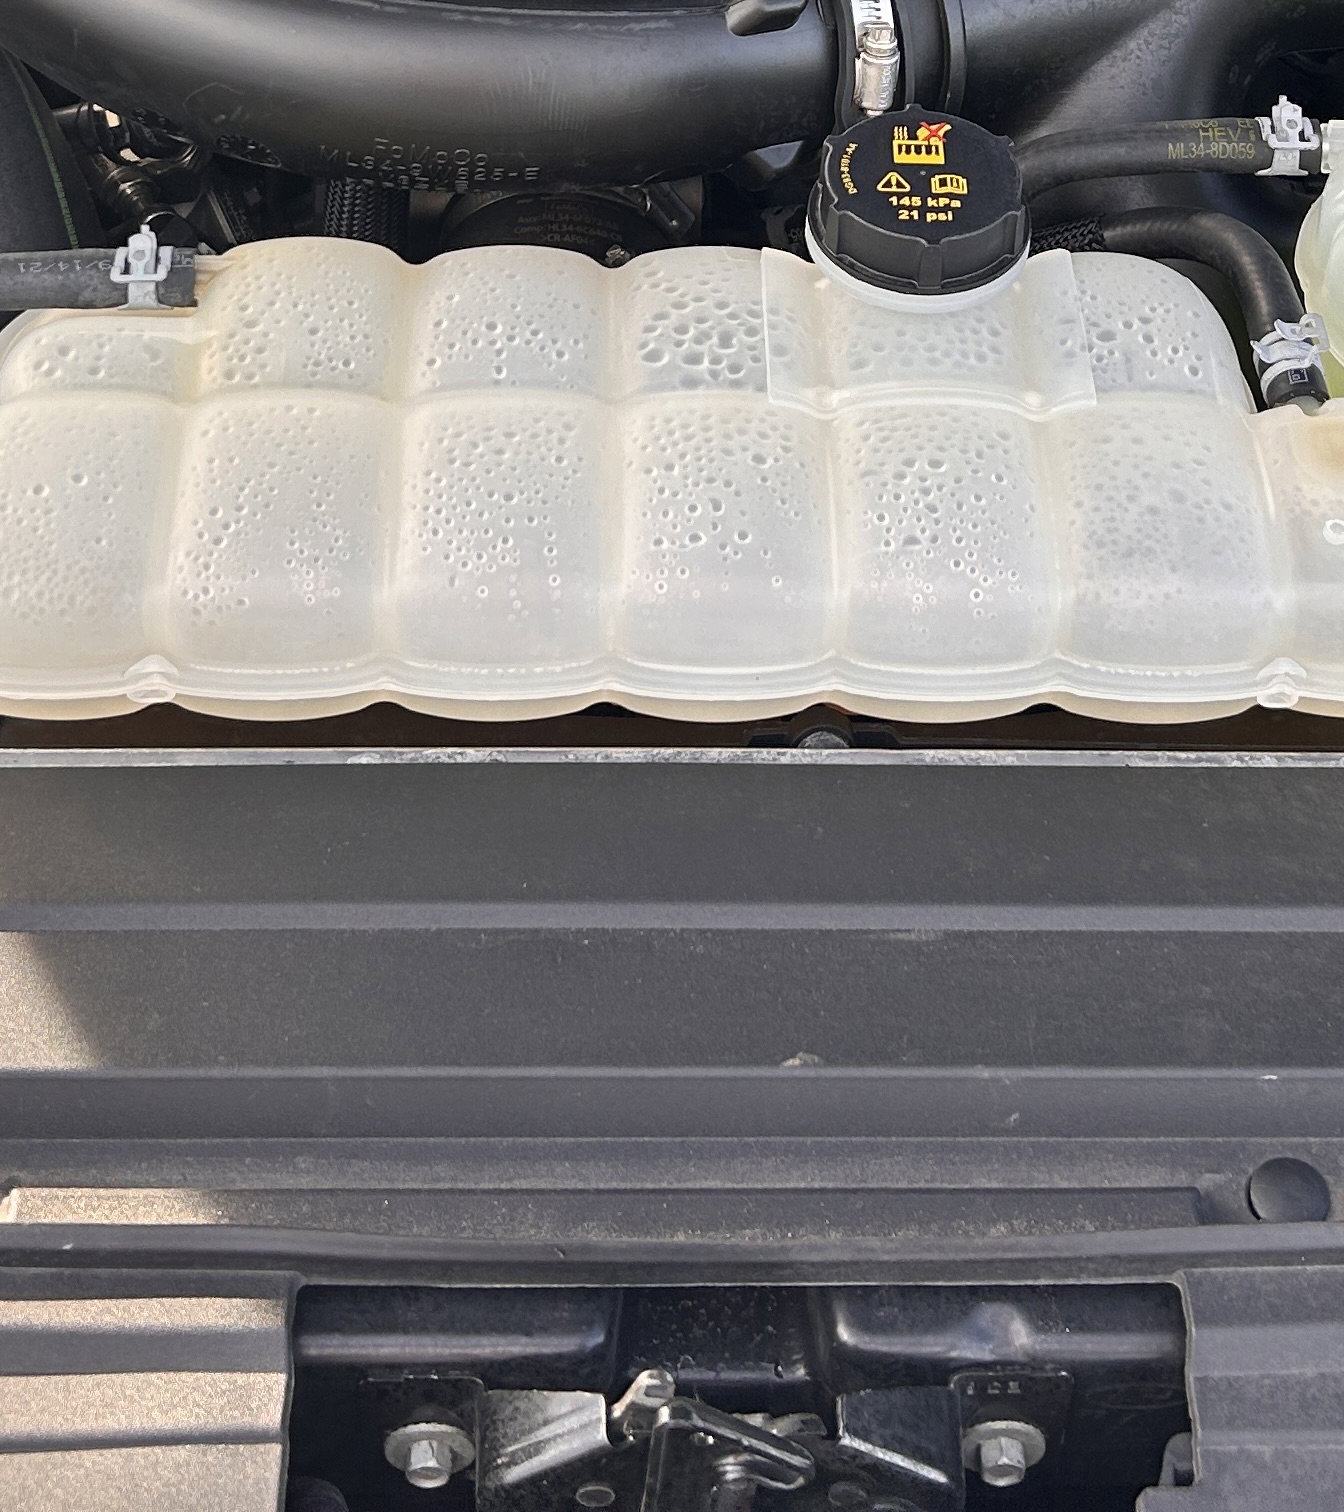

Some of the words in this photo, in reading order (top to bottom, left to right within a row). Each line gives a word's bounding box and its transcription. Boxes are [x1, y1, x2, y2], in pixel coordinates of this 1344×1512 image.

[1198, 126, 1242, 143] HEV
[888, 196, 923, 209] 145
[926, 196, 963, 209] kPa
[897, 209, 920, 222] 21
[925, 209, 954, 223] psi
